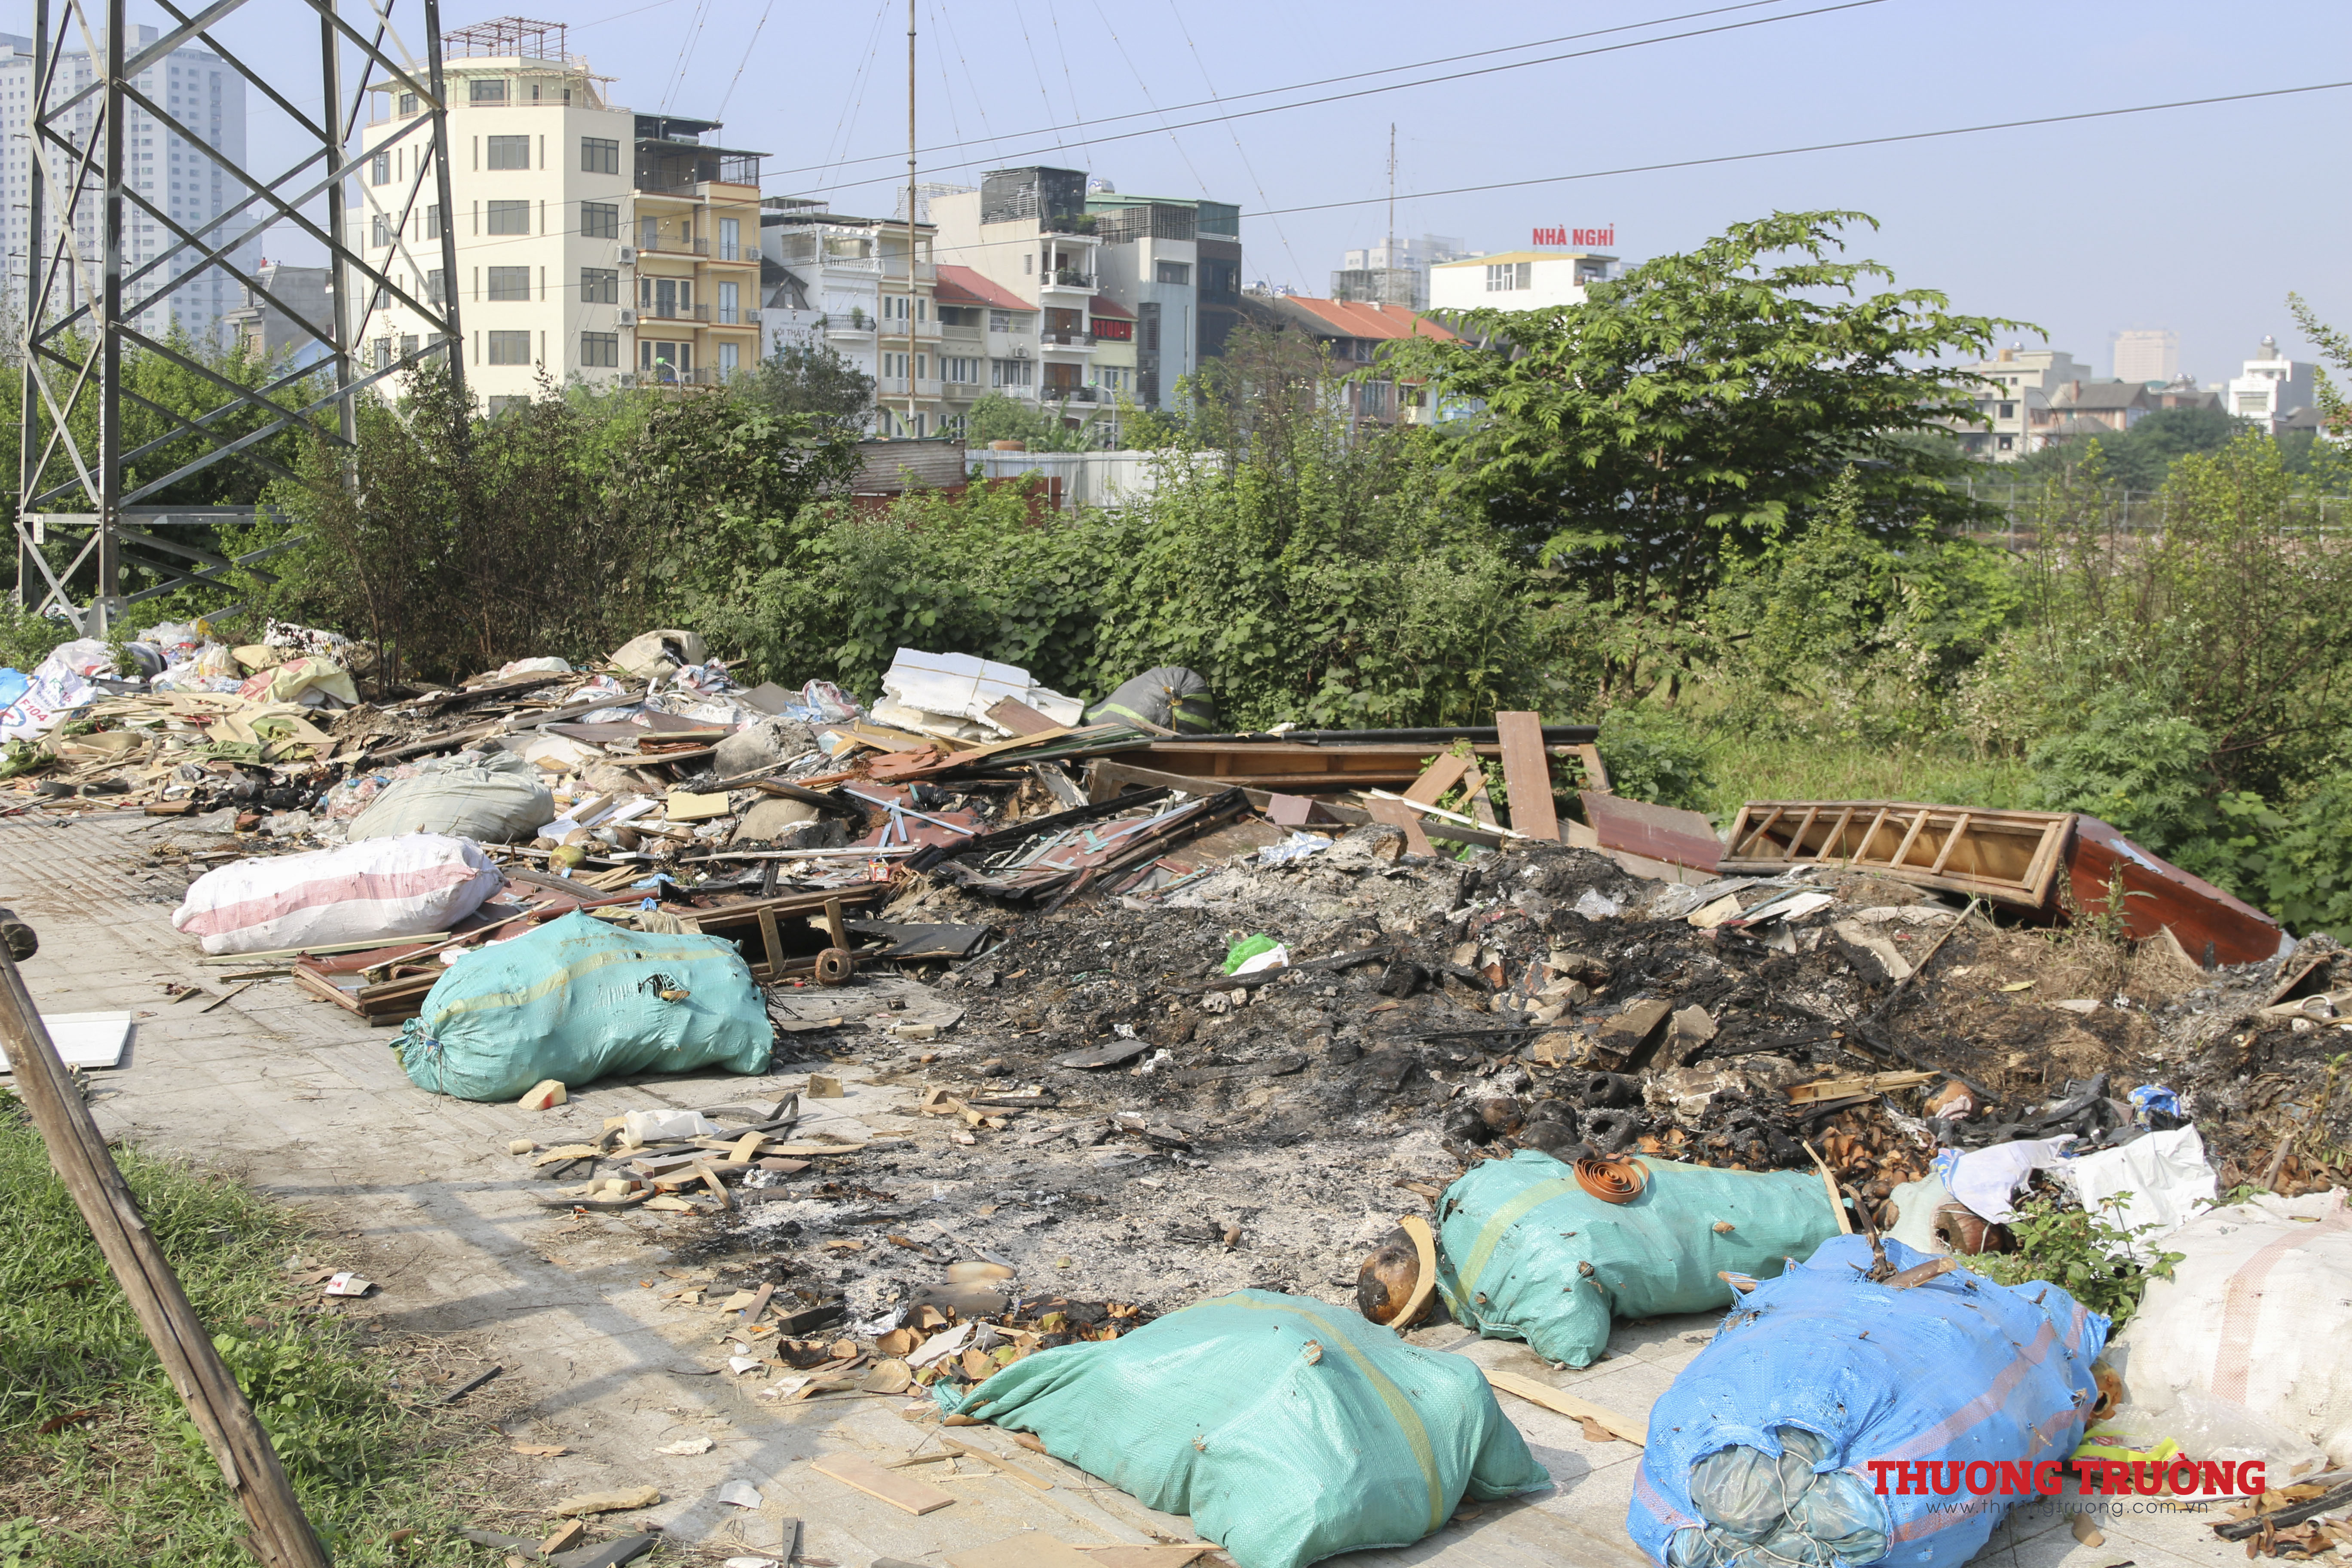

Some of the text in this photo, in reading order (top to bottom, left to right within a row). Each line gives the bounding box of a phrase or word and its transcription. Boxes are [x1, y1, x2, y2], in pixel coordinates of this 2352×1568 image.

[1533, 223, 1614, 246] NHÀ NGHỈ
[1093, 320, 1132, 339] STUDIO
[19, 698, 48, 722] F104
